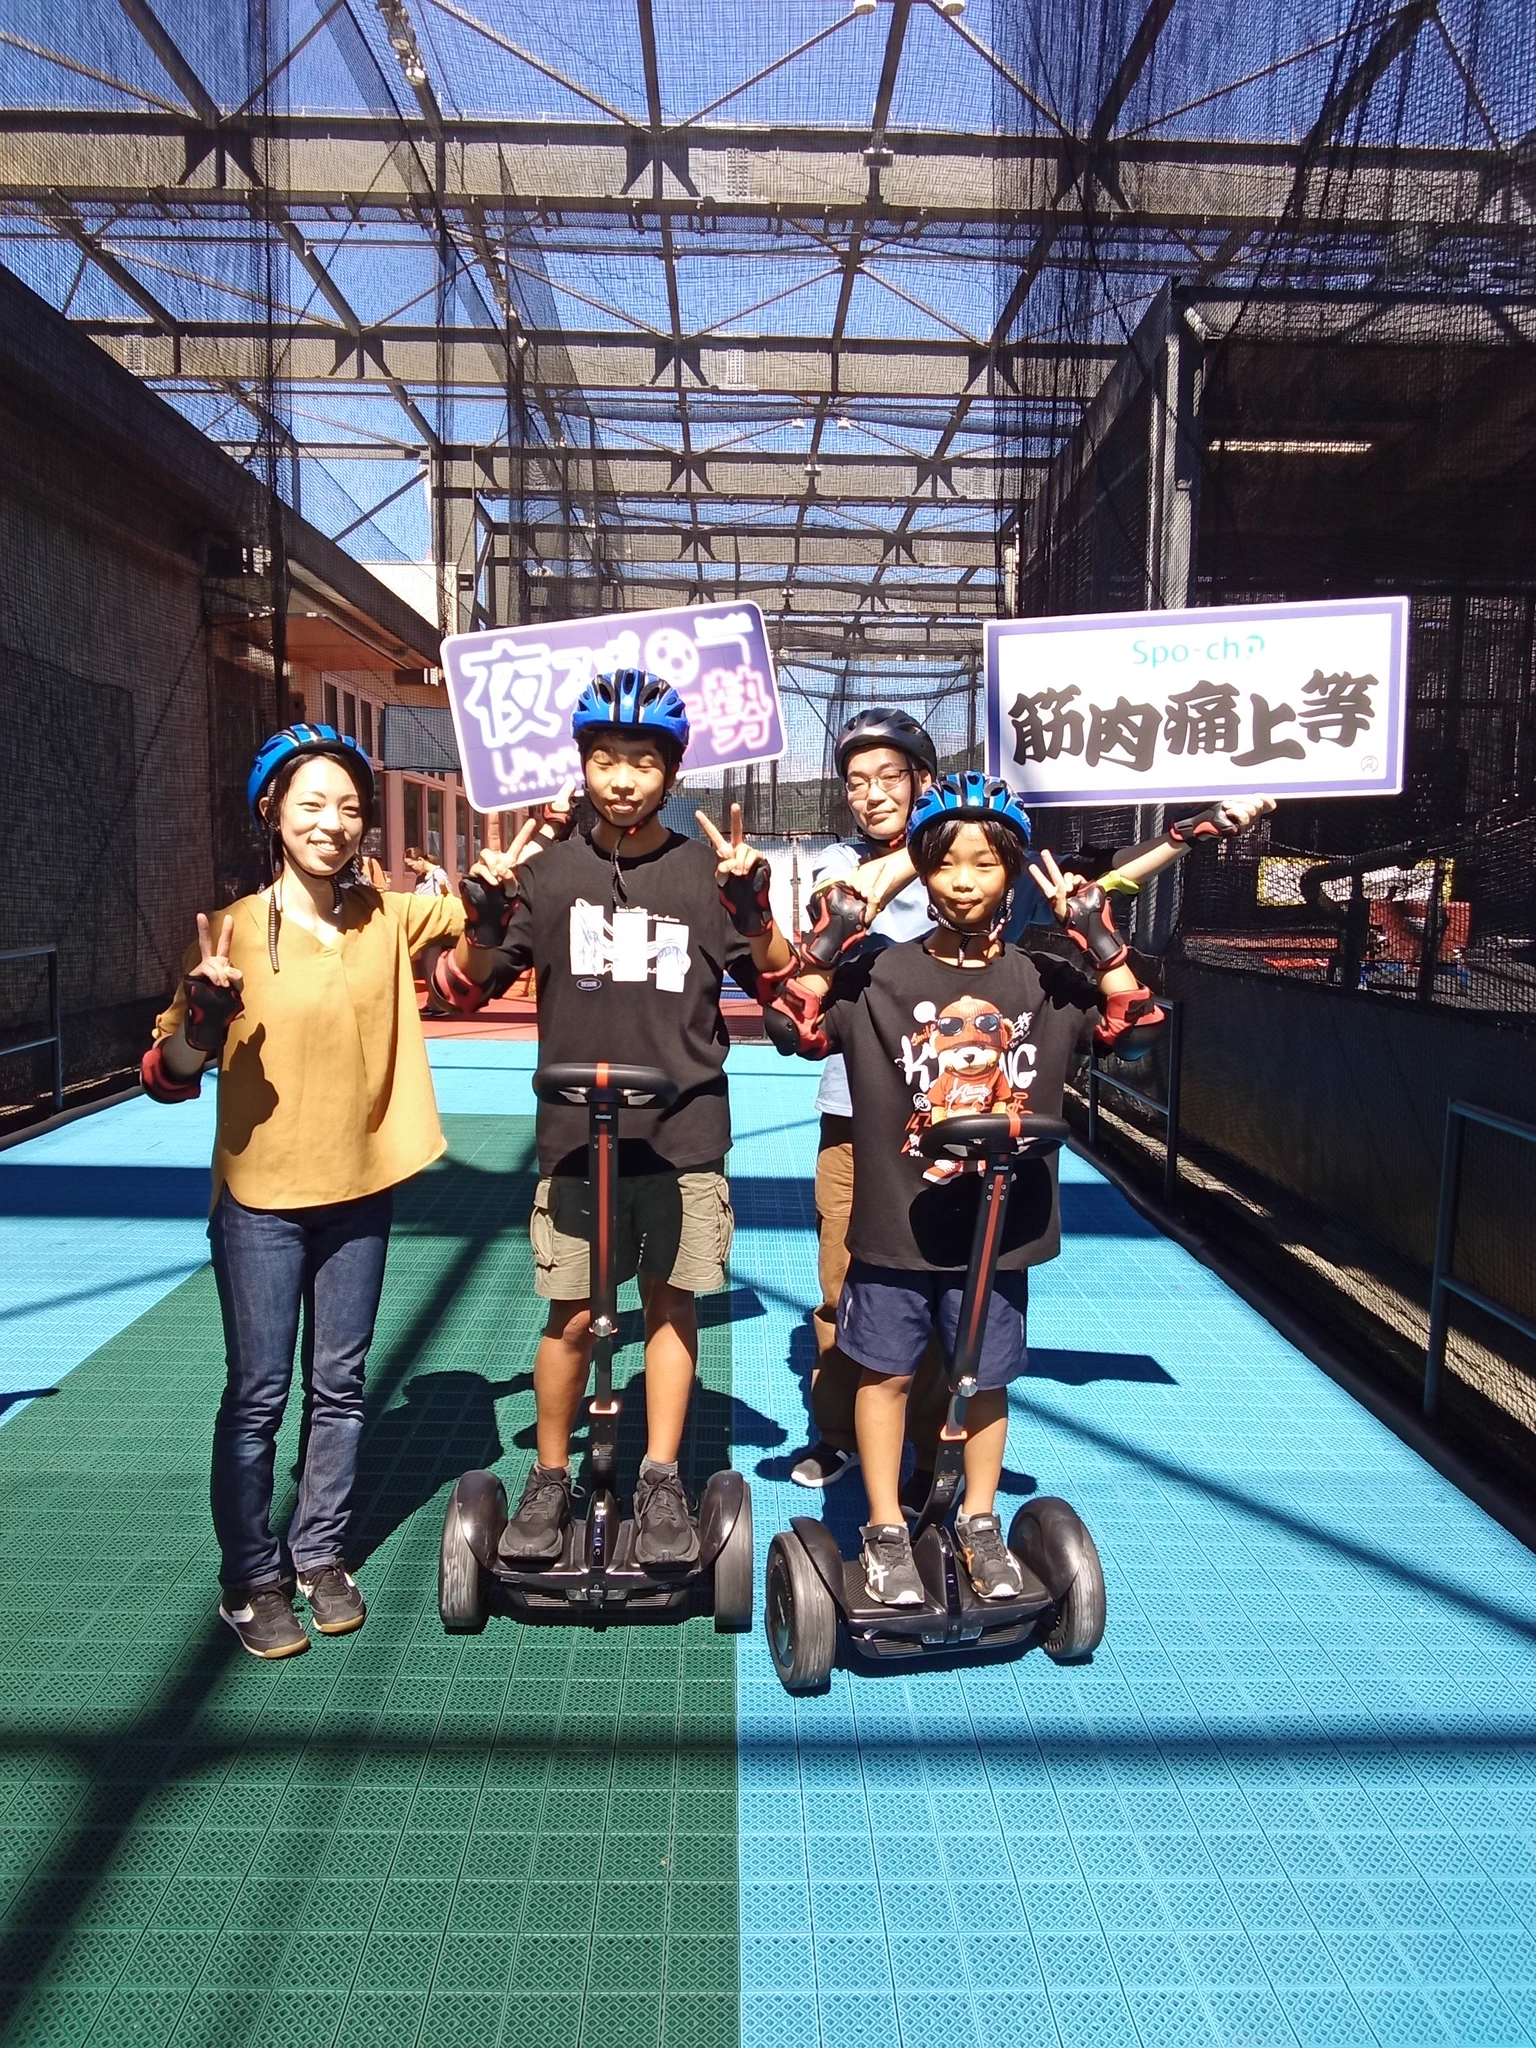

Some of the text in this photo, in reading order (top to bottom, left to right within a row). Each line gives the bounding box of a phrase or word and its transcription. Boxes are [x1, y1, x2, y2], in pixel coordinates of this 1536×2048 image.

[1007, 669, 1379, 772] 筋肉痛上等
